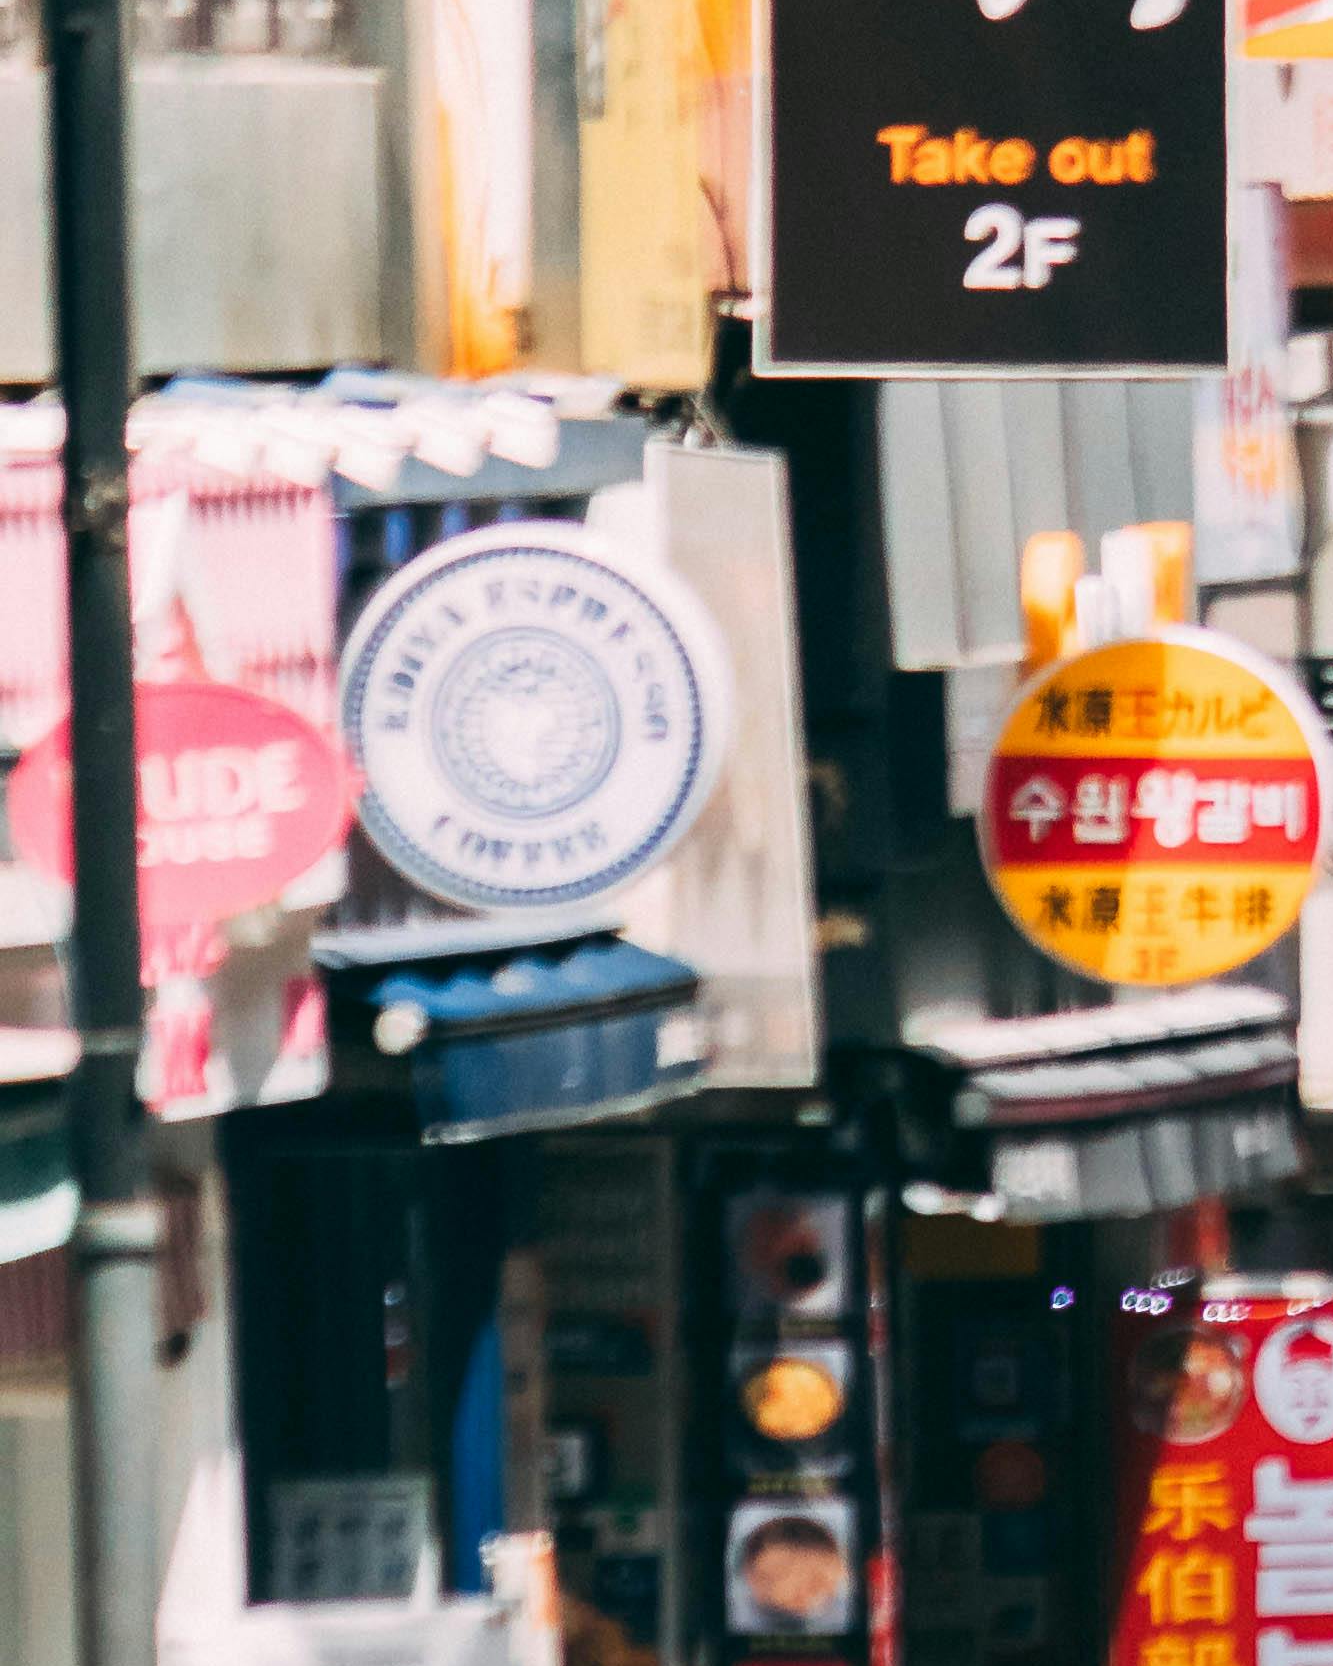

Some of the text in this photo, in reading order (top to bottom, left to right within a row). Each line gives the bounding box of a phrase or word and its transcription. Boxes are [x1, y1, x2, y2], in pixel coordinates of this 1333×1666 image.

[877, 125, 1155, 186] Take out
[962, 202, 1082, 292] 2F
